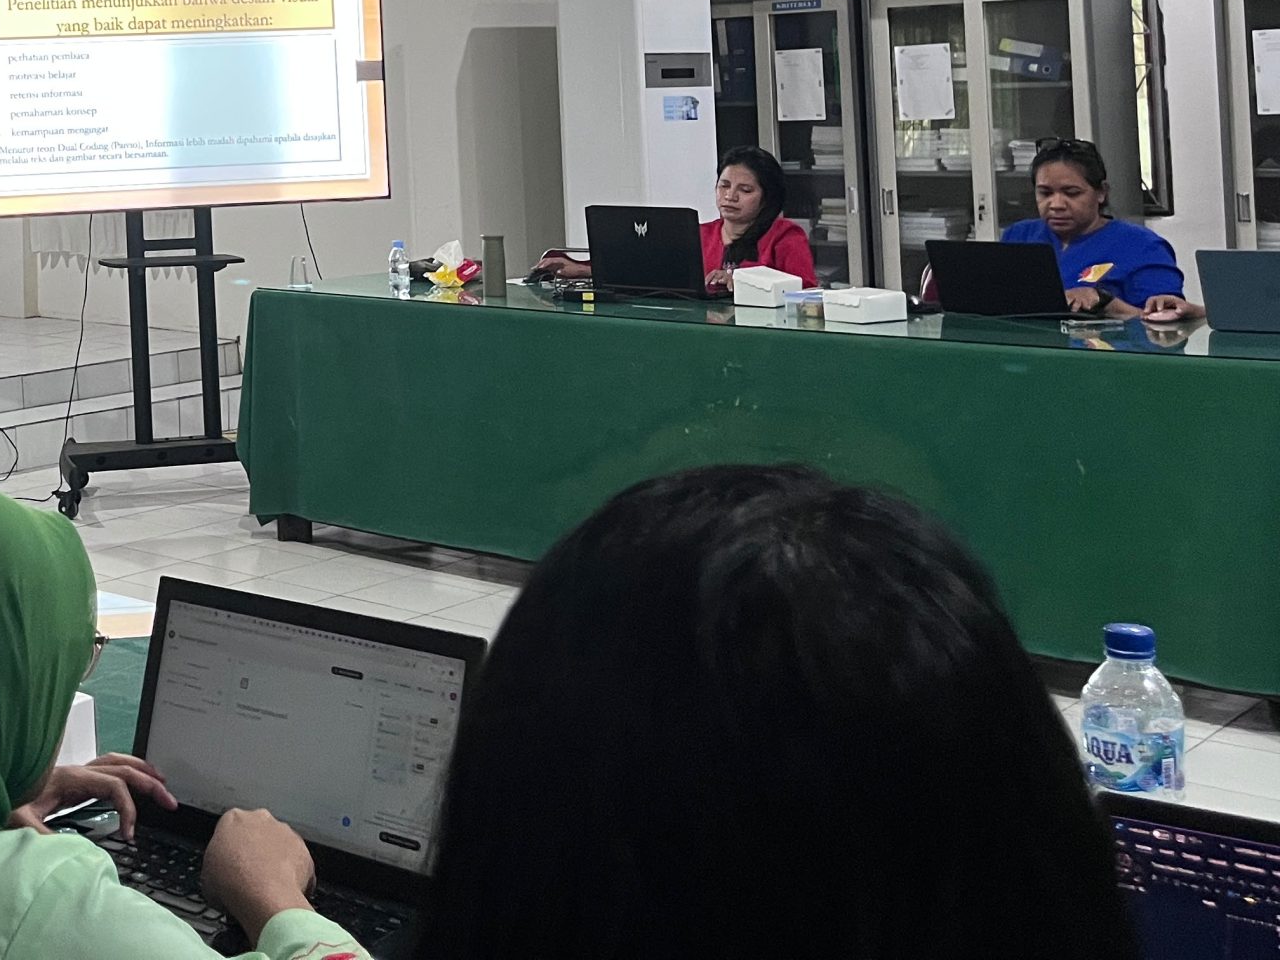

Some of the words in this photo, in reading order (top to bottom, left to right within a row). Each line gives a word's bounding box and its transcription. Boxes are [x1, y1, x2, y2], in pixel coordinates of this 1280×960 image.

[56, 22, 90, 36] yang
[94, 17, 124, 32] baik
[128, 16, 167, 34] dapat
[171, 13, 273, 31] meningkatkan:
[48, 70, 77, 80] belajar
[41, 88, 83, 98] informasi
[10, 108, 64, 120] pemahaman
[66, 107, 97, 118] konsep
[11, 128, 64, 138] kemampuan
[58, 143, 77, 152] Dual
[186, 137, 206, 147] lebih
[49, 154, 64, 163] dan
[66, 153, 96, 164] gambar
